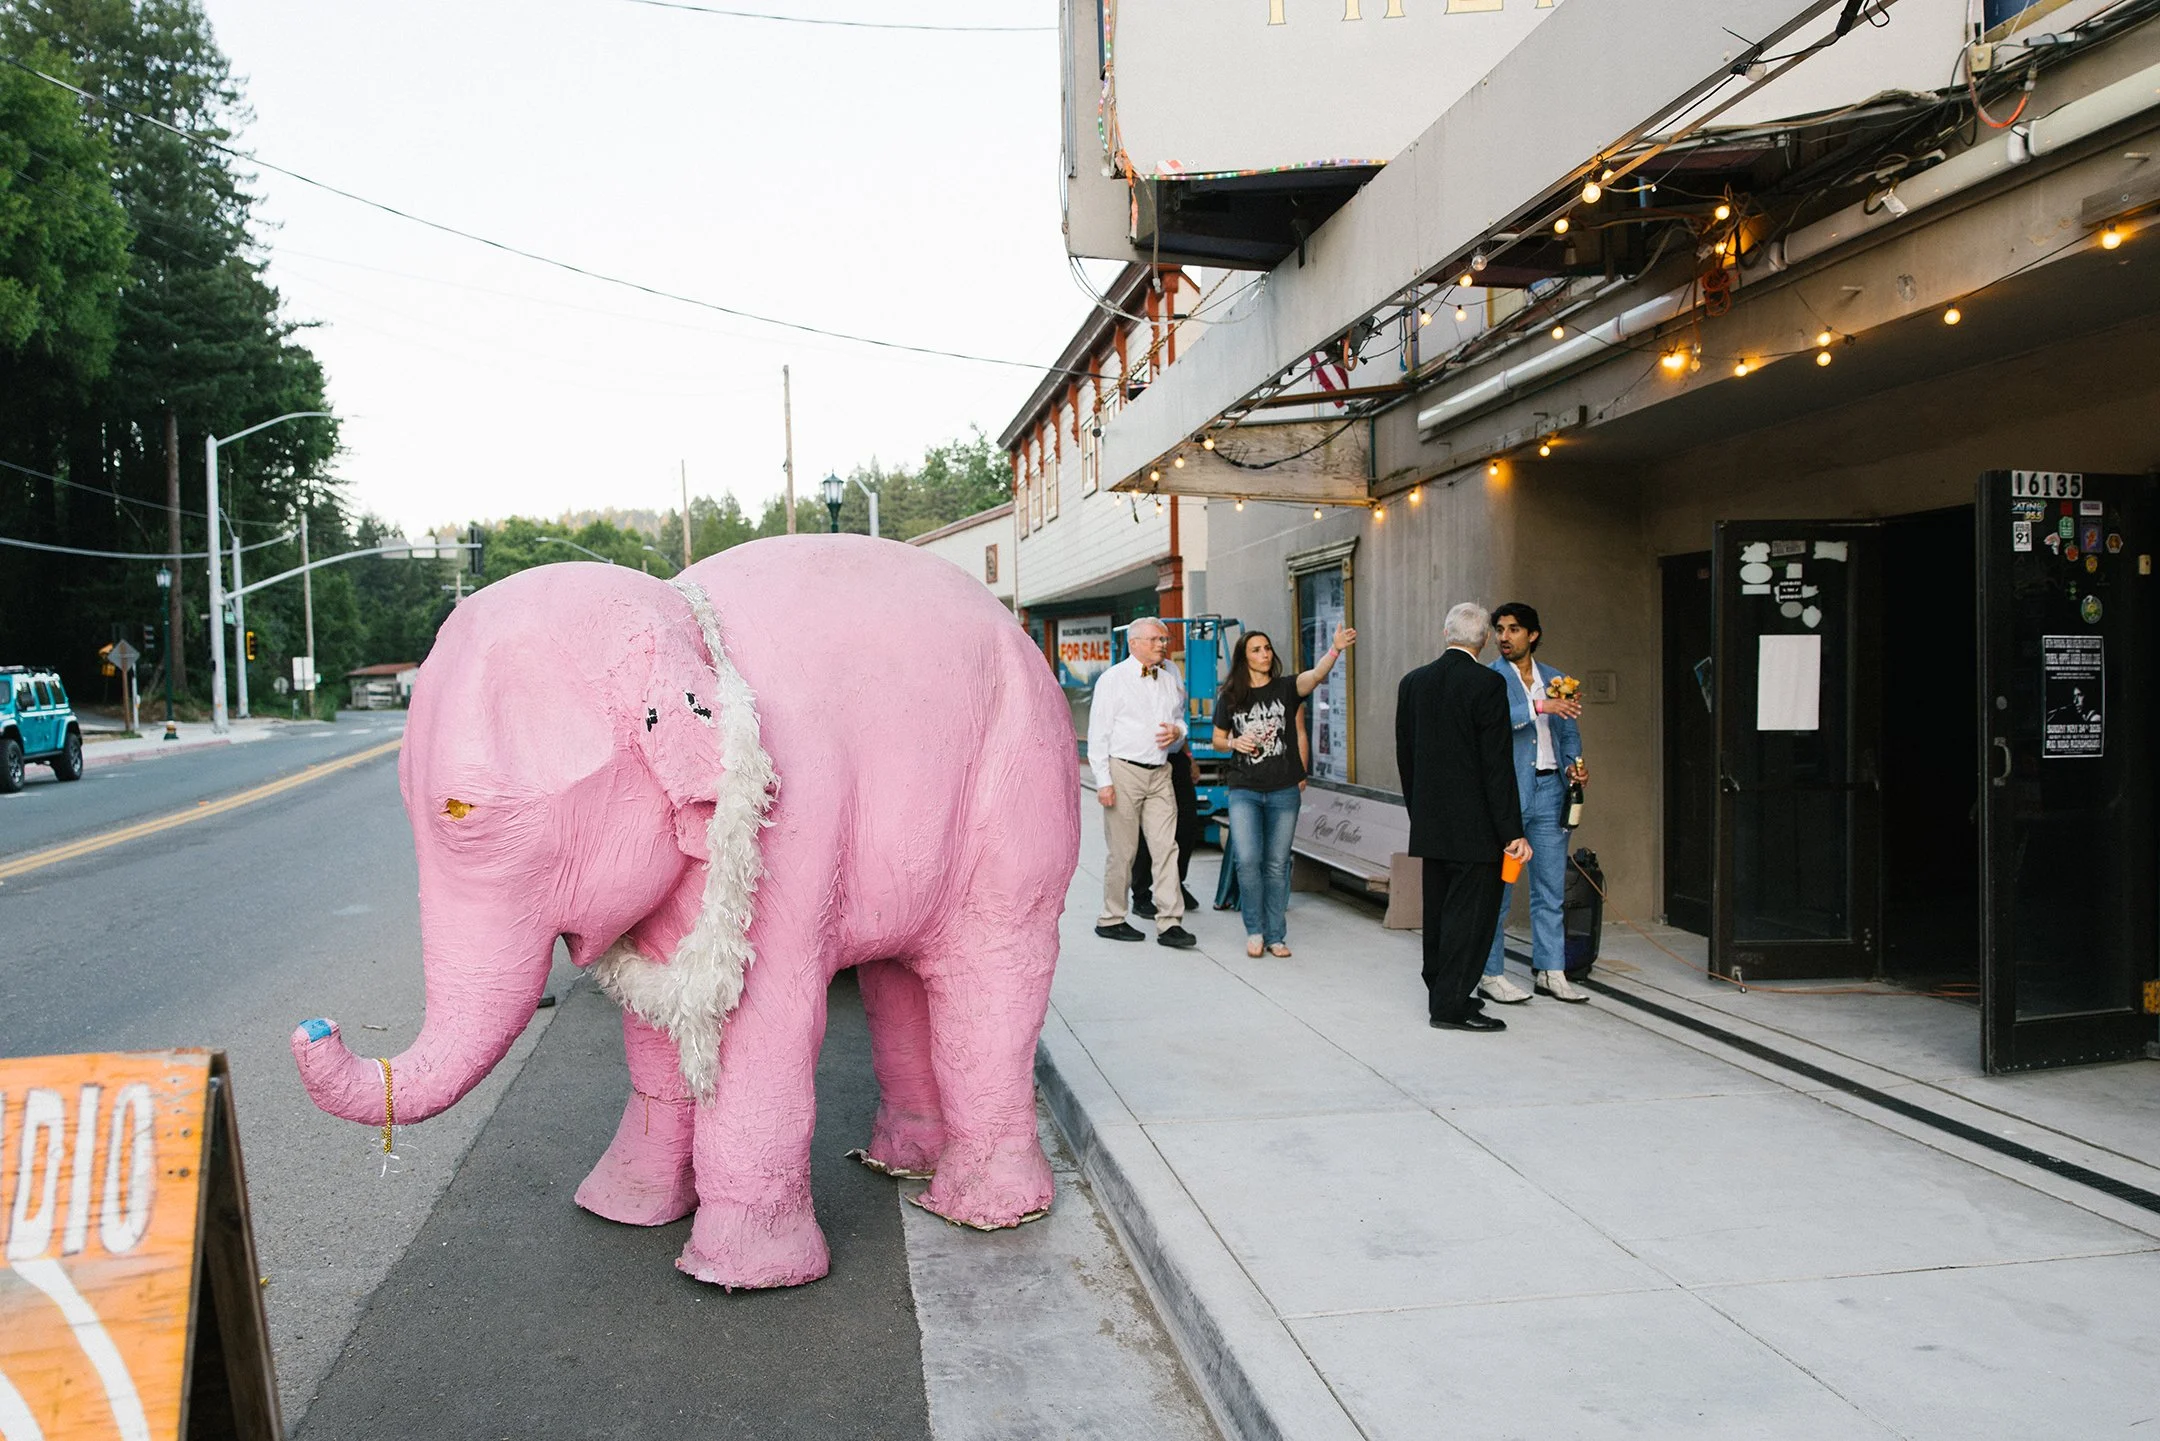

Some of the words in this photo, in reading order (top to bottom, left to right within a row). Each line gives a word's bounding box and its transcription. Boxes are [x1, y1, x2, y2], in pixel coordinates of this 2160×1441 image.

[2016, 472, 2081, 497] 16135
[2016, 532, 2030, 544] 91
[1060, 643, 1080, 661] FOR
[1082, 641, 1110, 661] SALE
[0, 1083, 156, 1261] DIO
